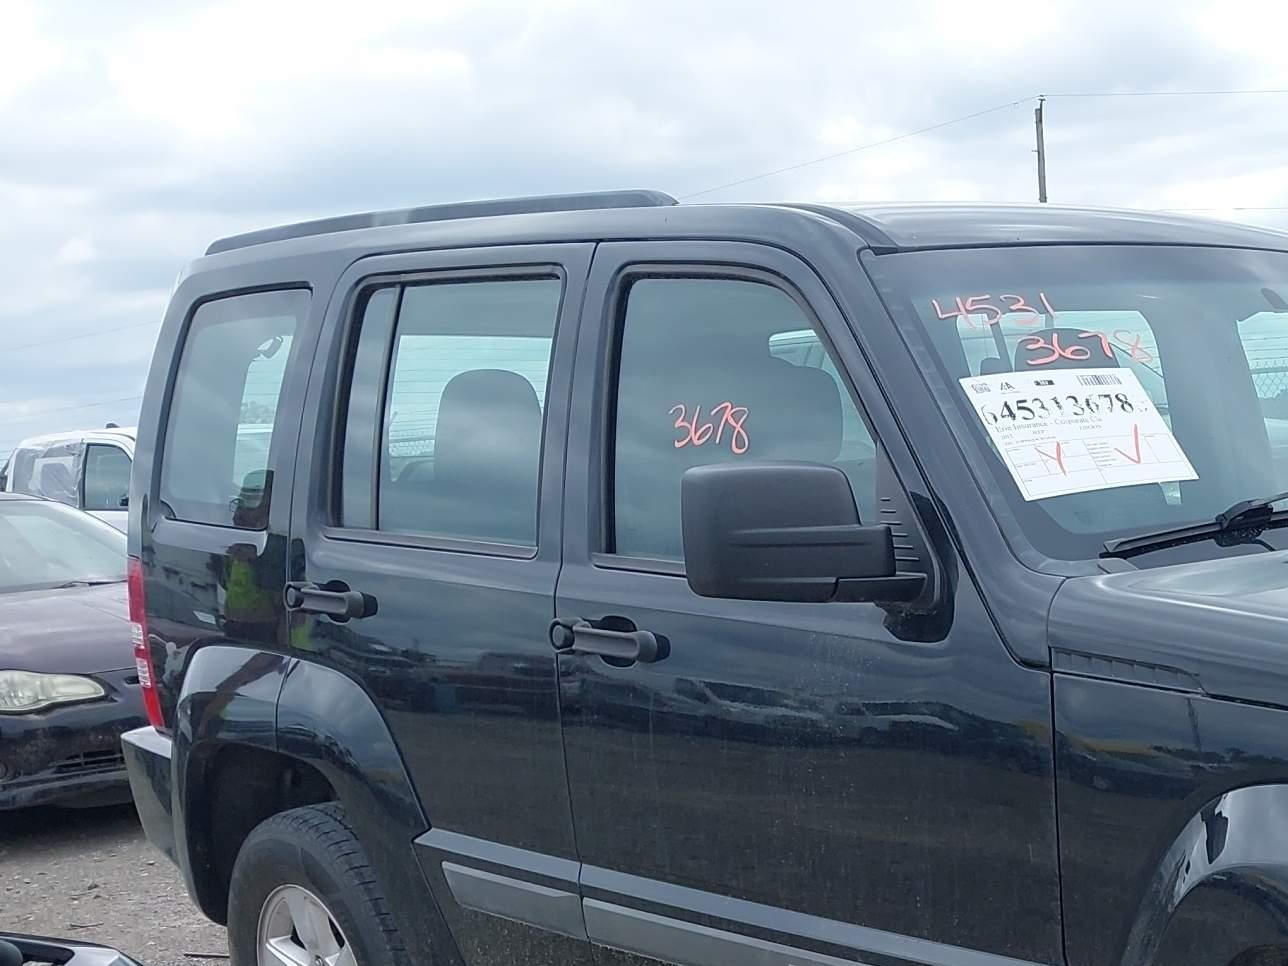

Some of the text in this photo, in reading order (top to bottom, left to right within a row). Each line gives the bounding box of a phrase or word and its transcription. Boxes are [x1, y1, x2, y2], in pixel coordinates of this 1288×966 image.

[931, 292, 1056, 331] 4531
[1018, 328, 1154, 366] 3678
[668, 401, 749, 454] 3678
